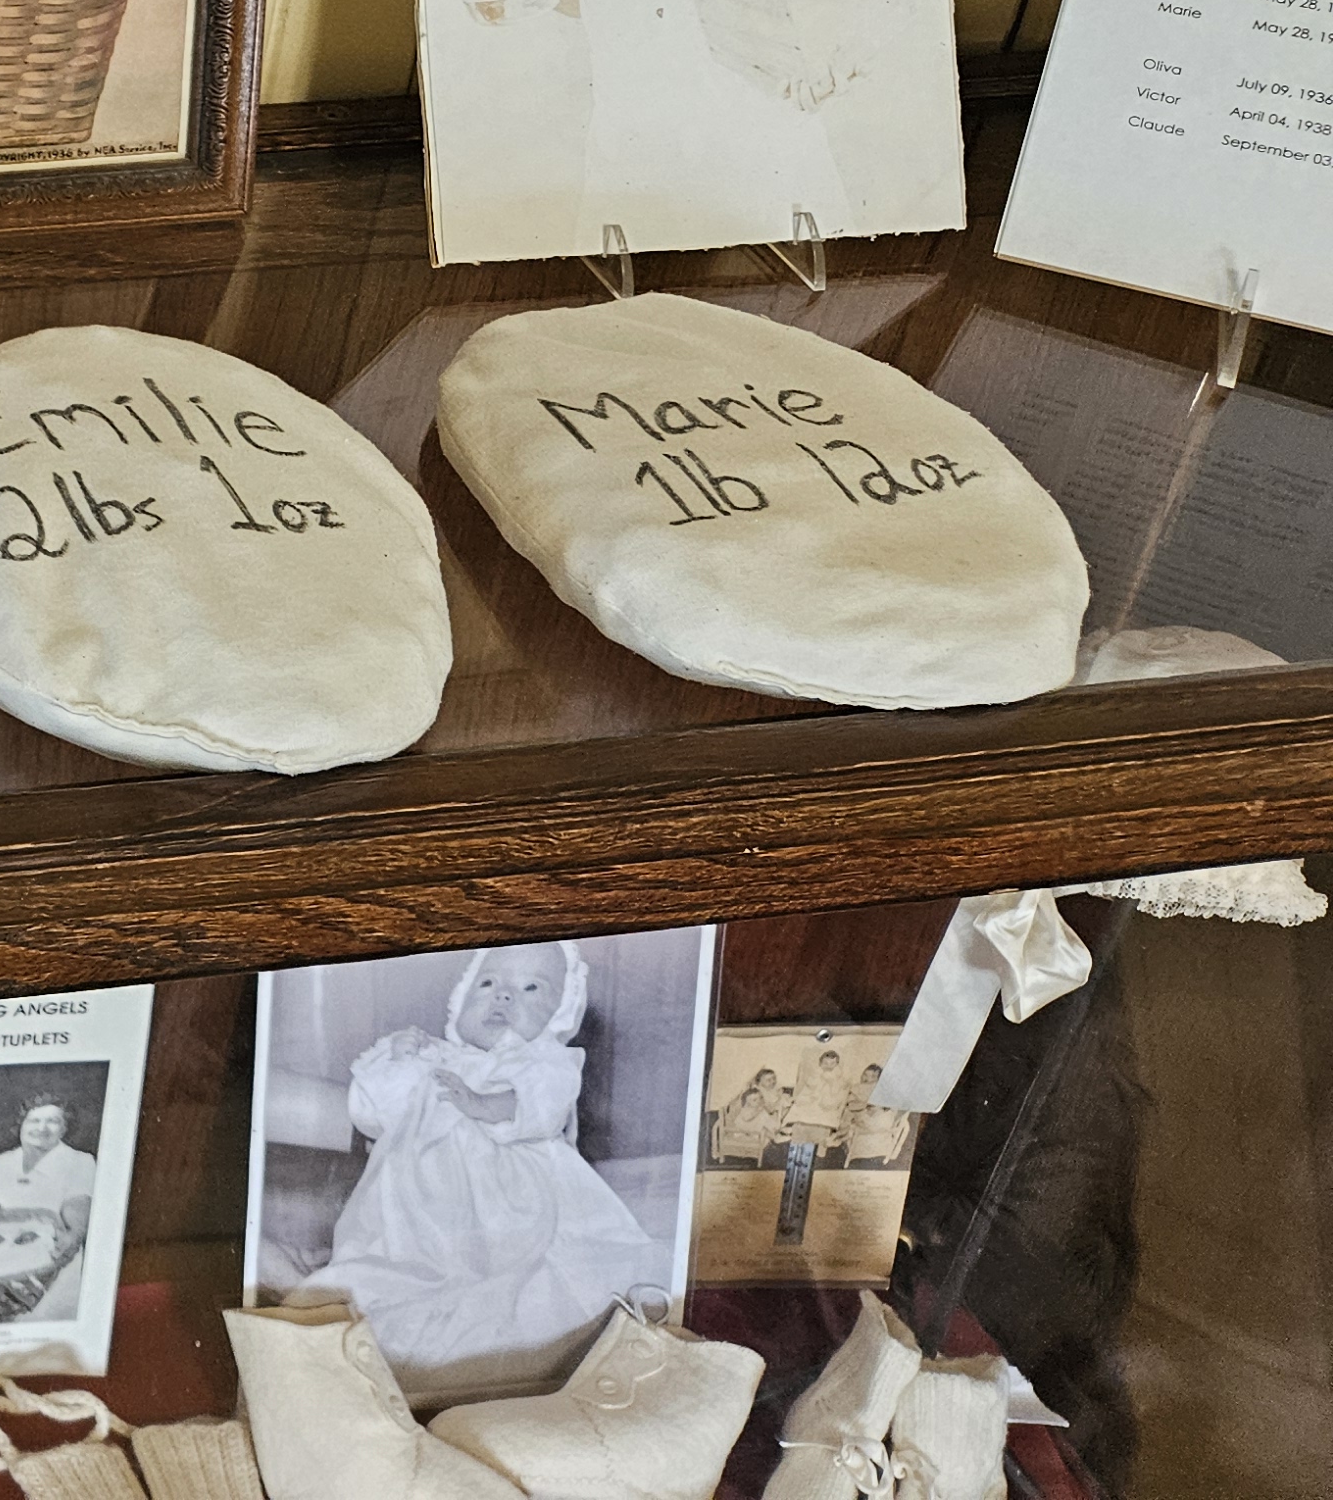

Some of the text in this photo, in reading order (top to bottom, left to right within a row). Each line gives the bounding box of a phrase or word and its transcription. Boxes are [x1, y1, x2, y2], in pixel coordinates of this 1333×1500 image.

[1157, 2, 1202, 19] Marie
[1252, 19, 1288, 37] May
[1291, 26, 1313, 41] 28,
[1143, 58, 1333, 105] Oliva July 09, 1936
[1136, 86, 1332, 136] Victor April 04, 1938
[1128, 115, 1185, 136] Claude
[1221, 134, 1310, 162] September
[537, 383, 844, 453] Marie
[199, 455, 346, 533] 1oz
[634, 447, 769, 526] 1lb
[795, 439, 985, 506] 12oz
[13, 1000, 89, 1017] ANGELS
